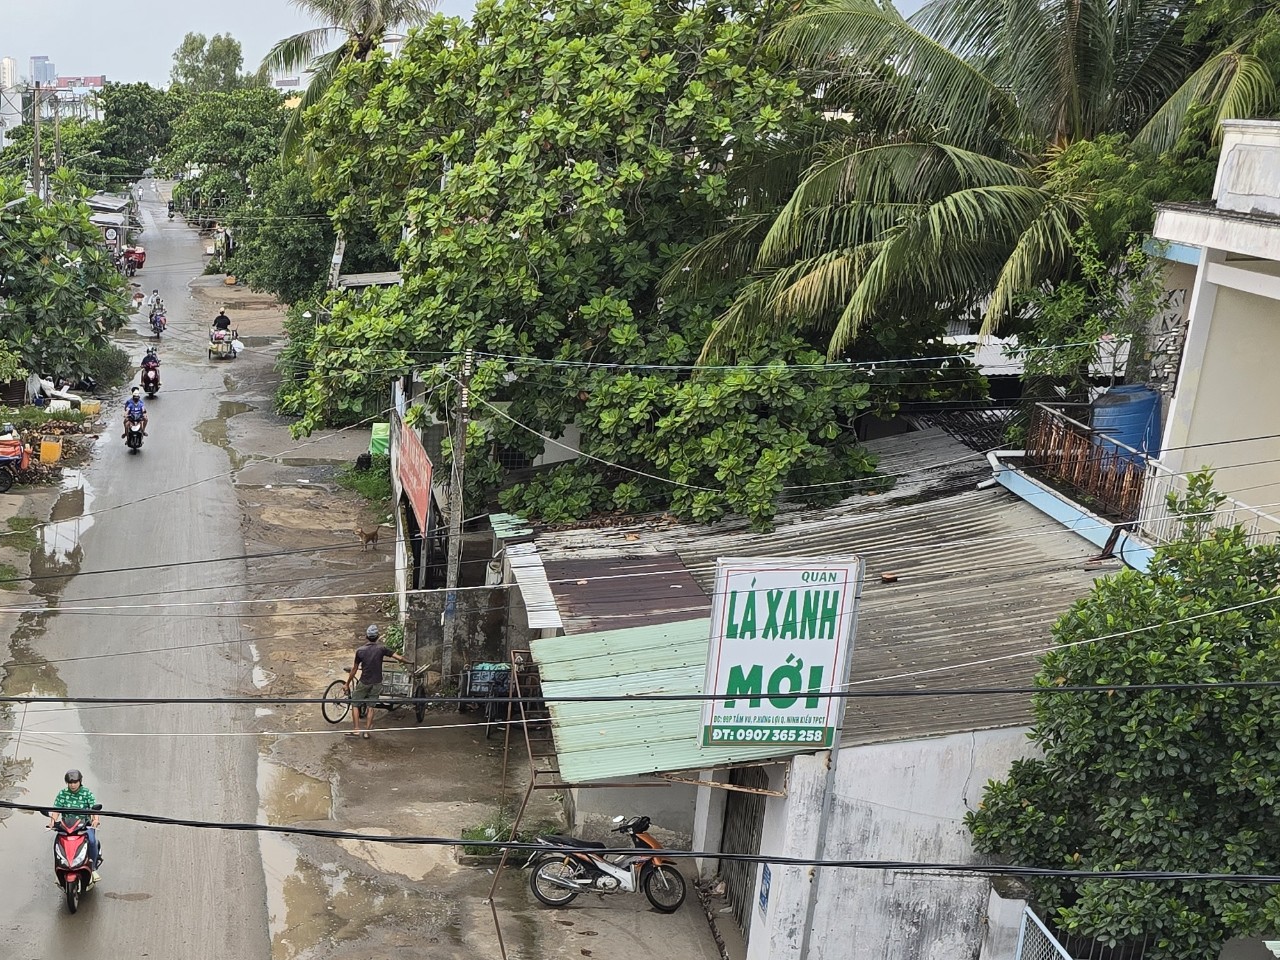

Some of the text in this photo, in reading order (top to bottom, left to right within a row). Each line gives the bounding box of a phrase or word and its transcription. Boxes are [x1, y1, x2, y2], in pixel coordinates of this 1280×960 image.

[726, 576, 839, 640] LÁ XANH
[724, 653, 824, 709] MỚI
[712, 729, 822, 742] ĐT: 0907 365 258
